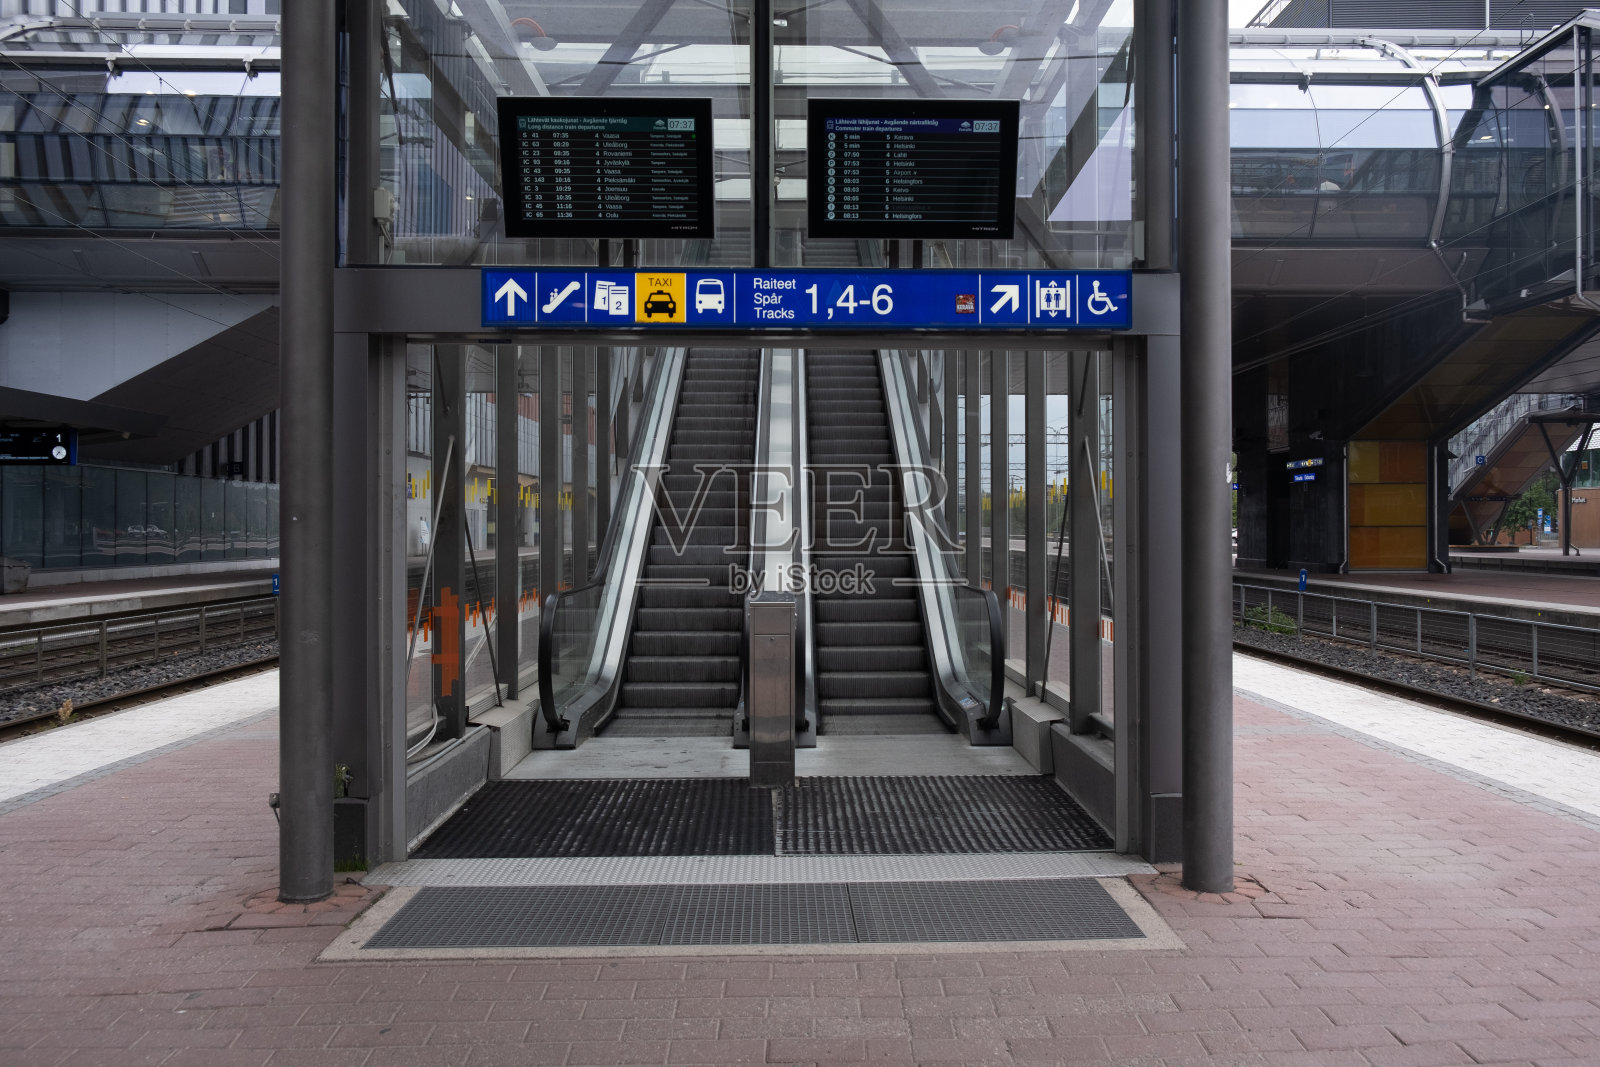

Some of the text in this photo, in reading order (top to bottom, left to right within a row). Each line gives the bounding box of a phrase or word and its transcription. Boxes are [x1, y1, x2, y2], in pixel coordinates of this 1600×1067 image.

[669, 120, 692, 128] 07:37
[974, 122, 998, 130] 07:37
[648, 278, 672, 286] TAXI
[754, 278, 796, 290] Raiteet
[754, 292, 782, 306] Spår
[805, 284, 894, 320] 1,4-6
[754, 307, 795, 319] Tracks
[56, 434, 61, 442] 1
